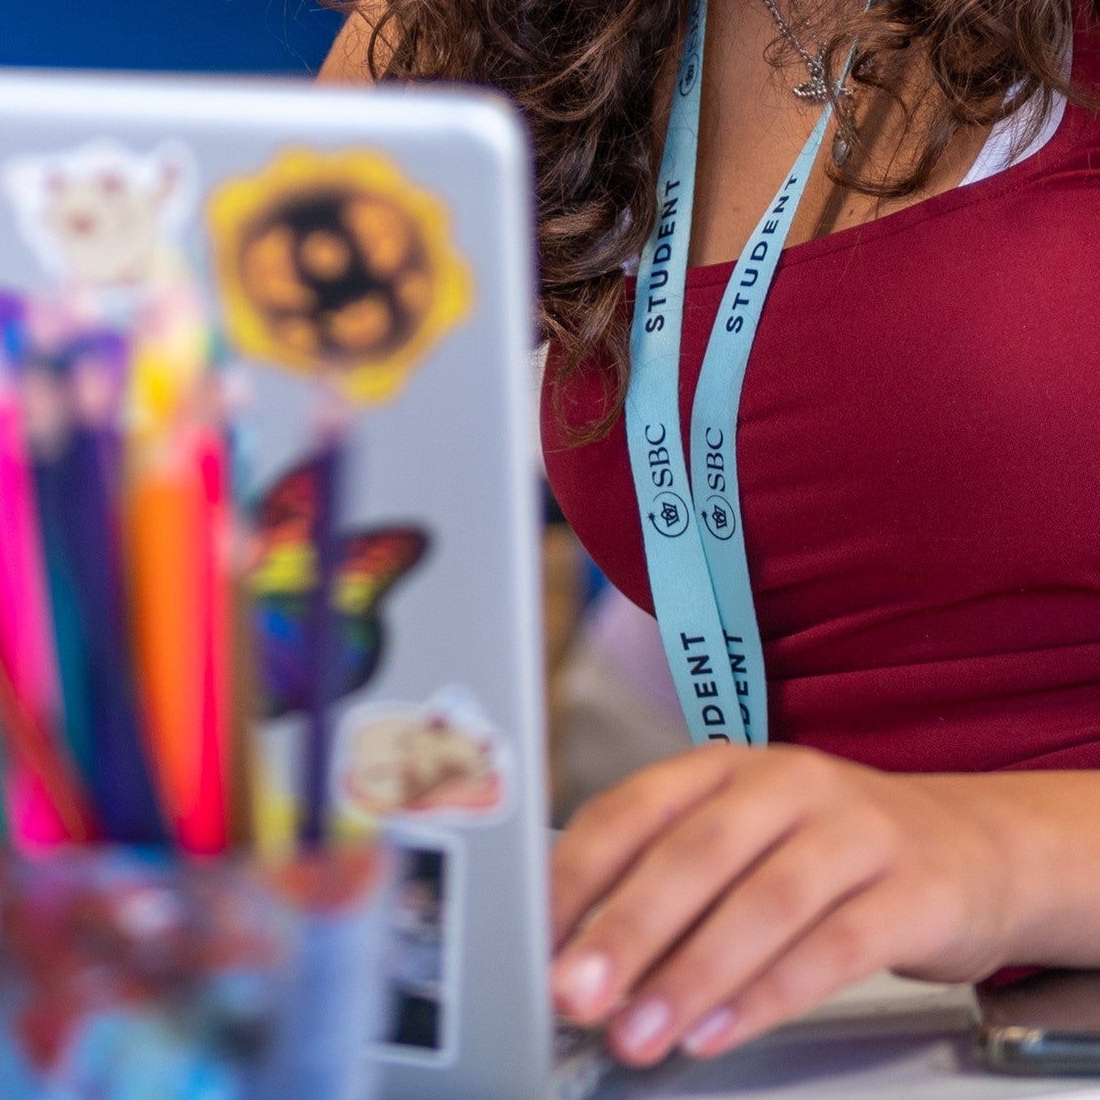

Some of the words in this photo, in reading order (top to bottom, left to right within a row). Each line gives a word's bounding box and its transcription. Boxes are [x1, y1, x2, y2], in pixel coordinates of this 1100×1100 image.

[645, 180, 680, 333] STUDENT
[726, 175, 798, 334] STUDENT
[644, 423, 674, 488] SBC
[705, 427, 726, 492] SBC
